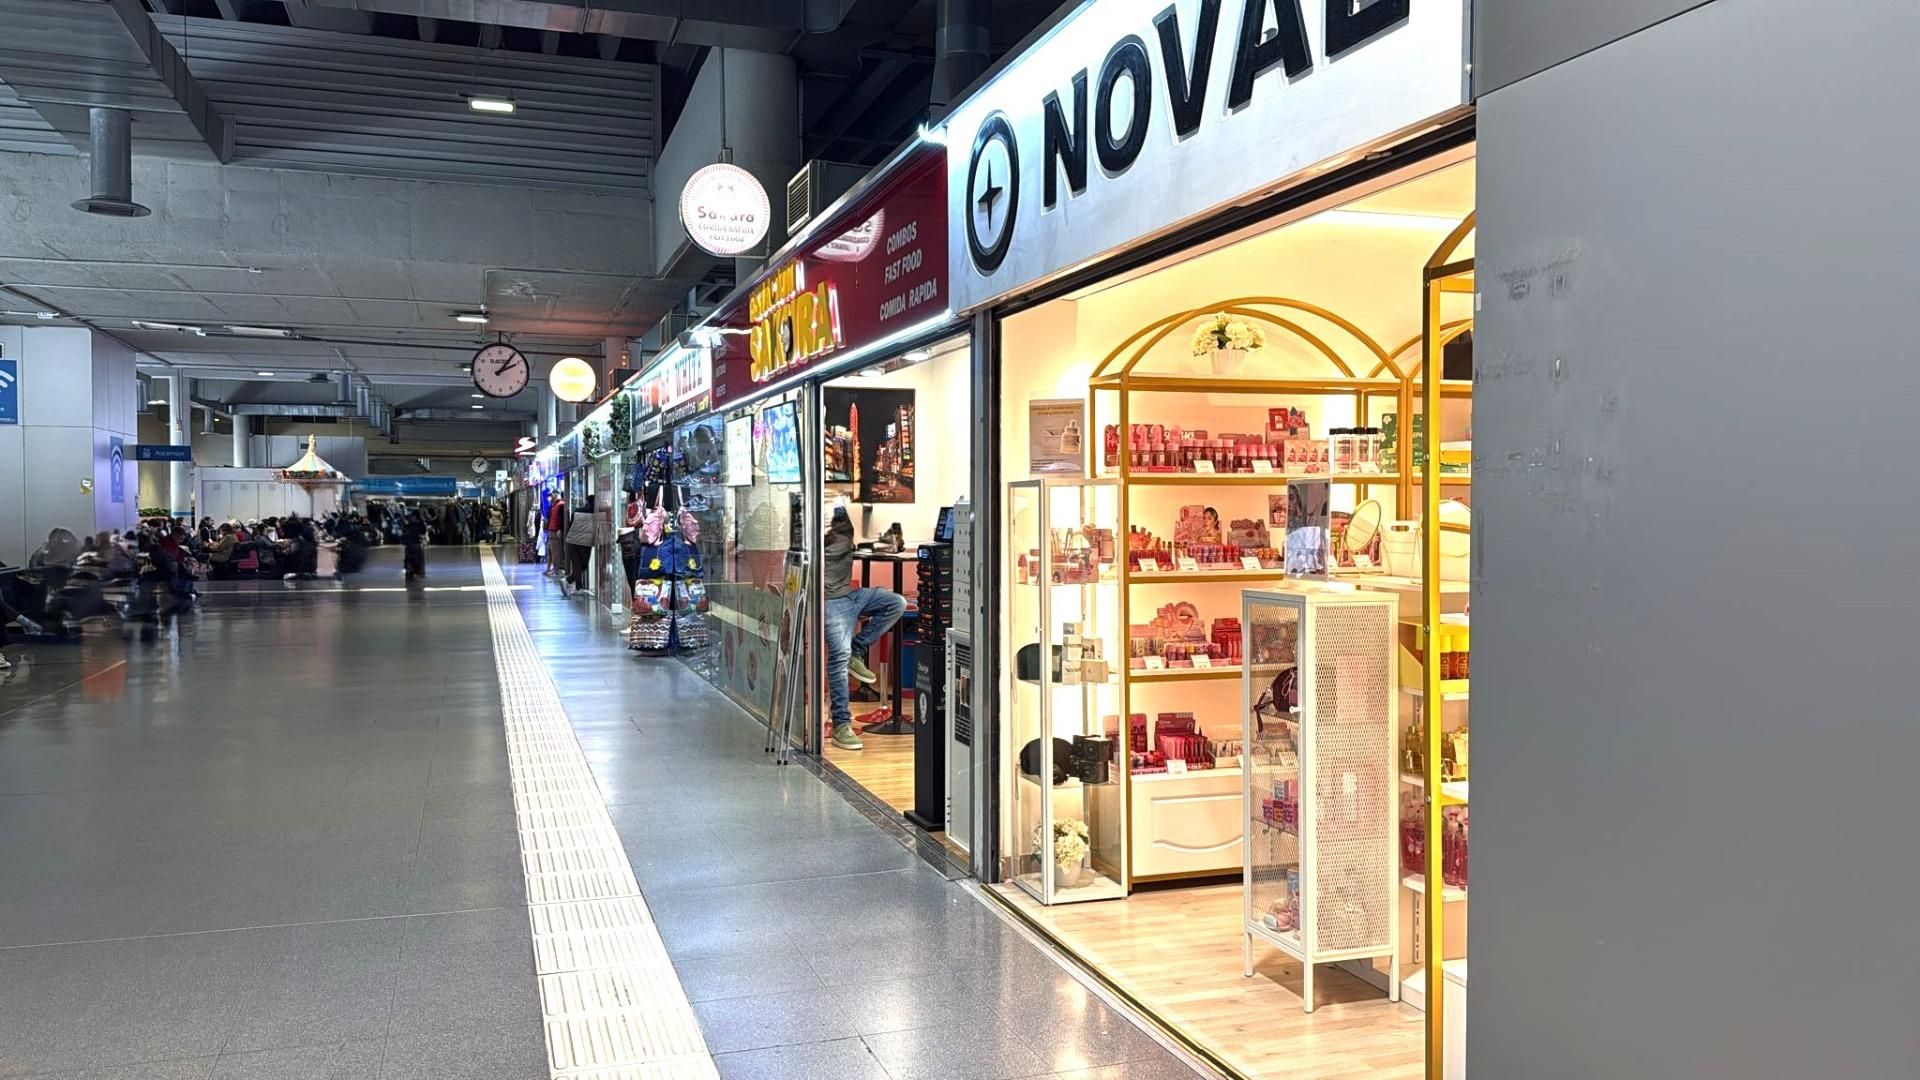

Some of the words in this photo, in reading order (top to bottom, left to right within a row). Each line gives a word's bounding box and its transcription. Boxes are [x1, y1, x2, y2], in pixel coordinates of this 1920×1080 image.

[886, 220, 918, 255] COMBOS
[884, 259, 901, 285] FAST
[901, 248, 922, 275] FOOD
[880, 293, 906, 322] COMIDA
[908, 277, 937, 308] RAPIDA
